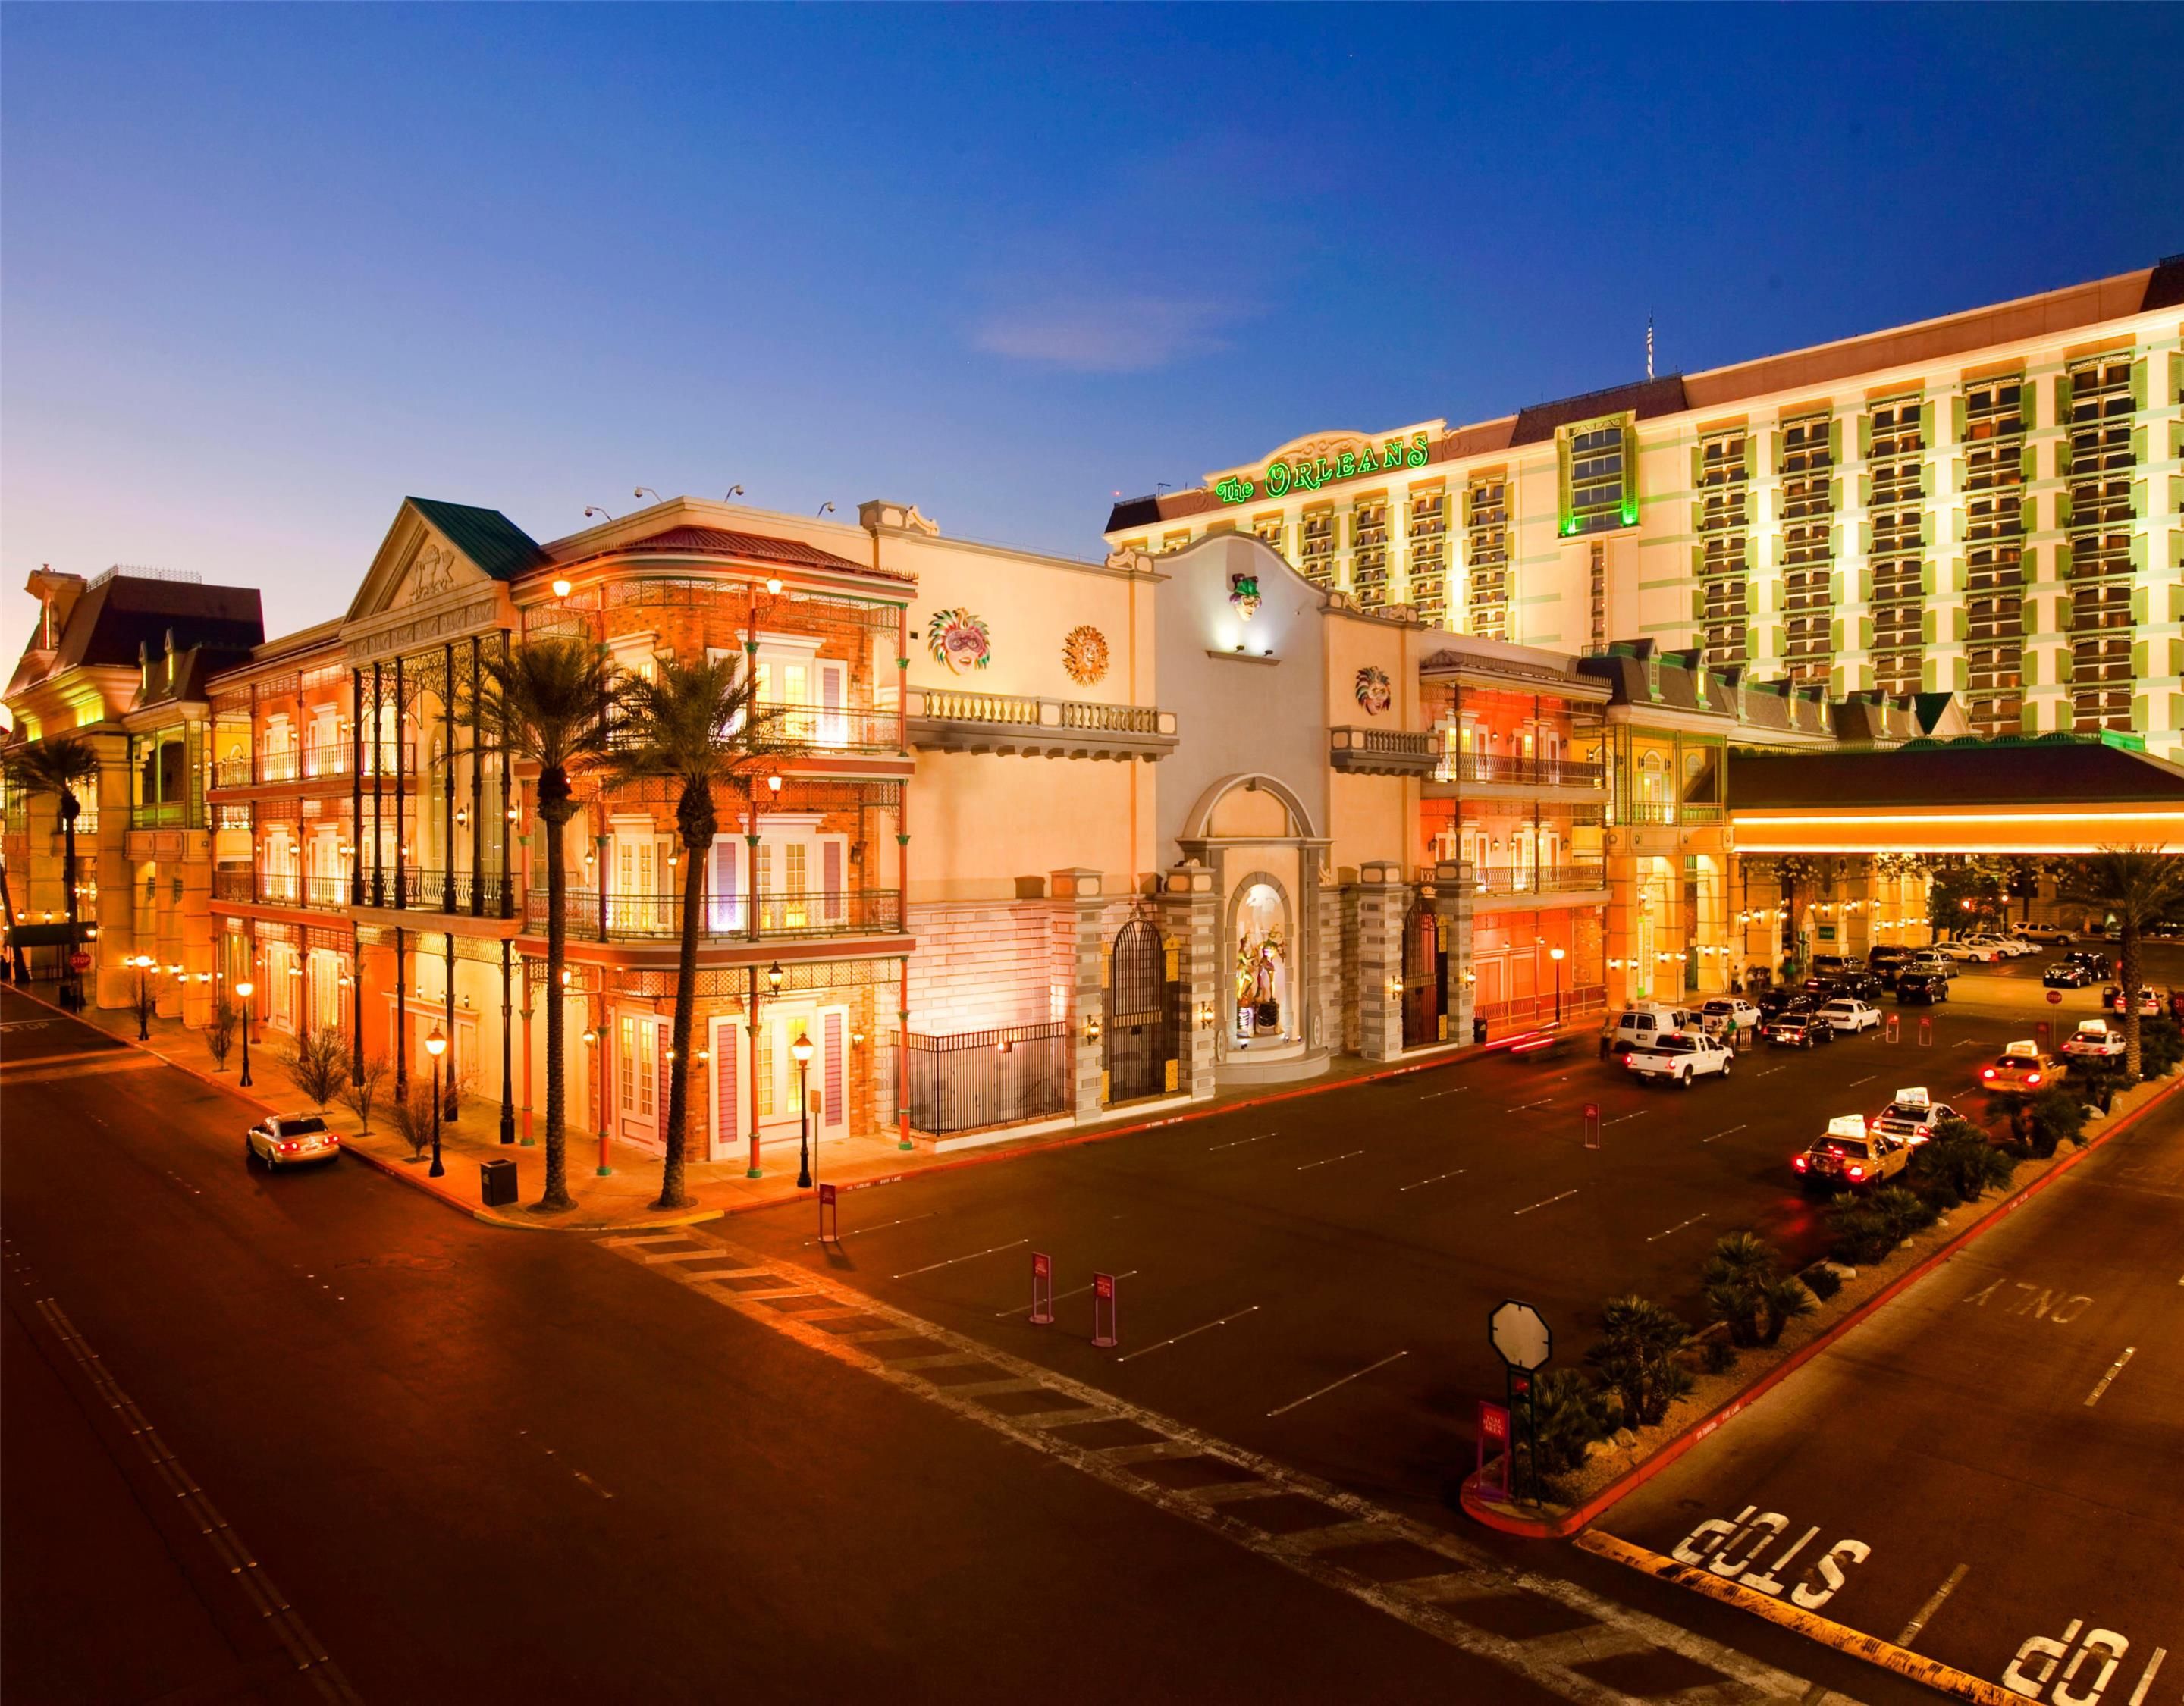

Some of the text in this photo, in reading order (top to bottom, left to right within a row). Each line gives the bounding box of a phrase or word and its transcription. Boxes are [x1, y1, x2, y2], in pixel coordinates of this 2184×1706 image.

[1216, 434, 1429, 503] The ORLEANS
[2175, 999, 2184, 1008] ST
[1, 1021, 49, 1032] STOP
[1963, 1278, 2095, 1323] ONLY
[1671, 1505, 1872, 1609] STOP
